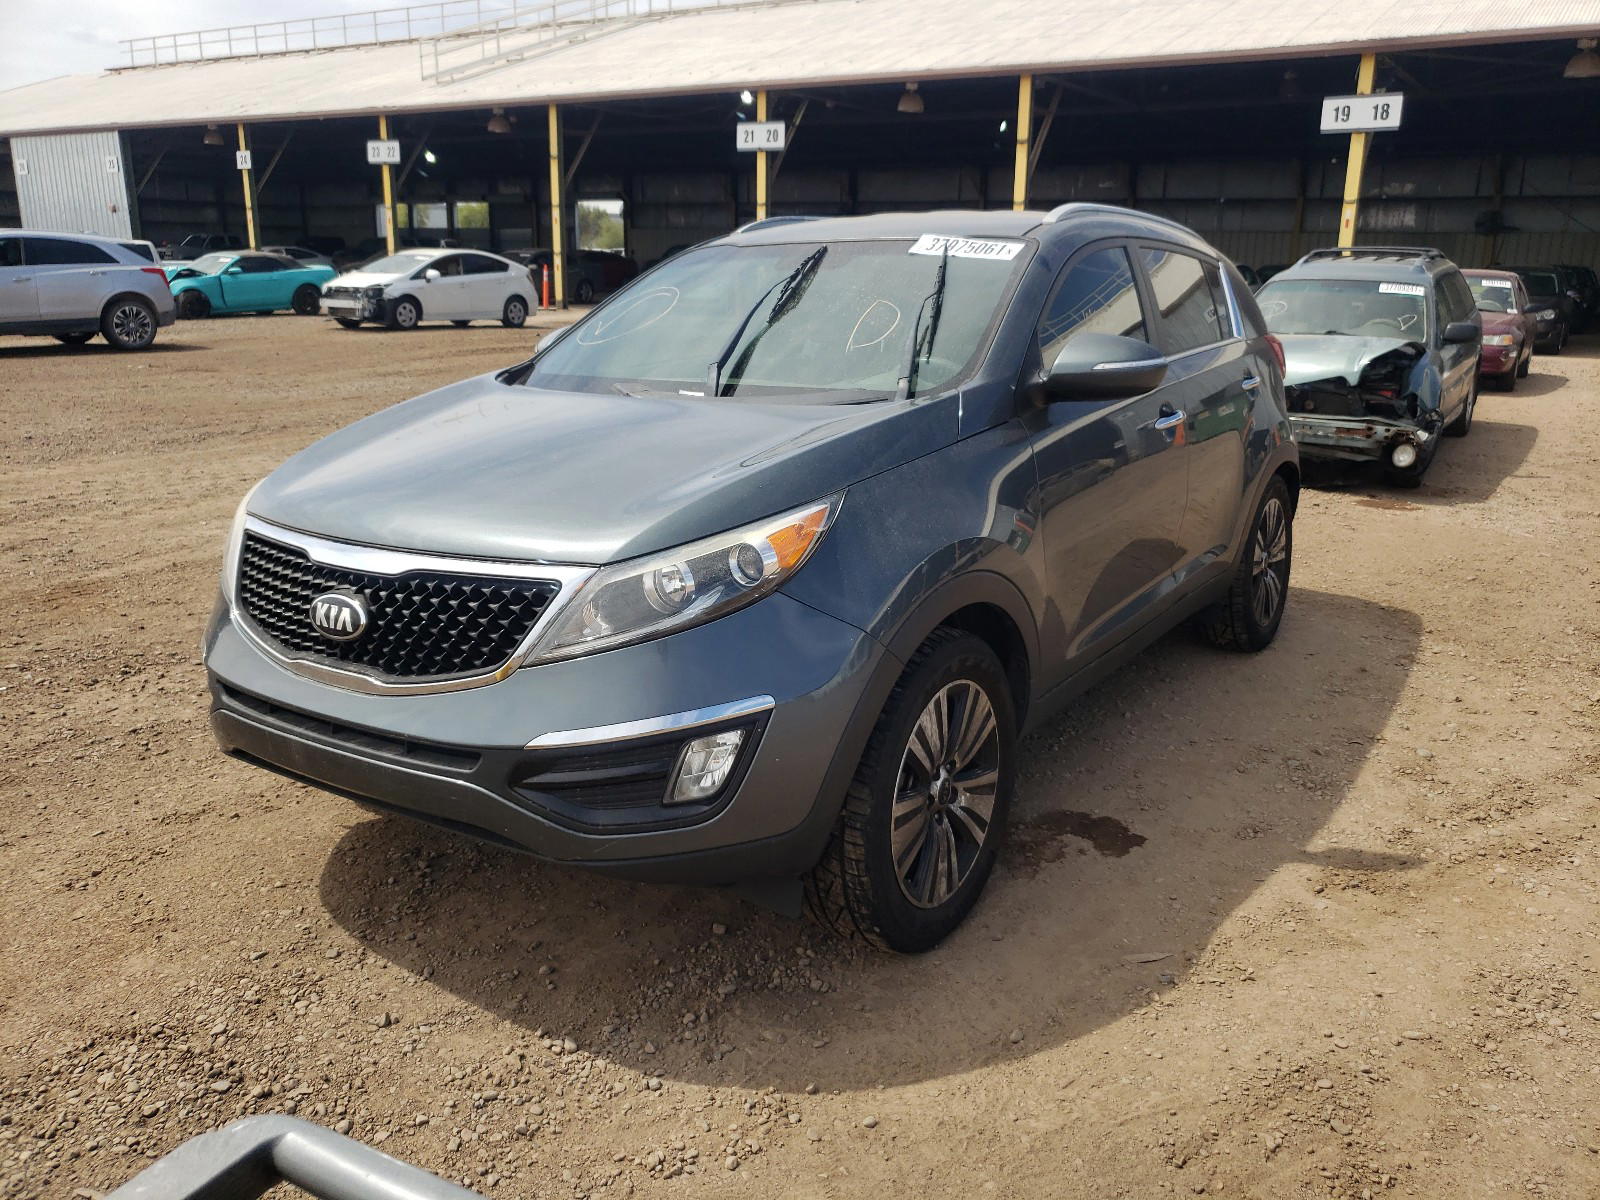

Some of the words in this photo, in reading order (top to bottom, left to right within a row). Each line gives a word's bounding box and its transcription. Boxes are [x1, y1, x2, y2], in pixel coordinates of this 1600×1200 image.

[1333, 105, 1351, 122] 19
[1372, 103, 1391, 121] 18
[743, 129, 754, 143] 21
[766, 128, 779, 143] 20
[315, 601, 354, 633] KIA
